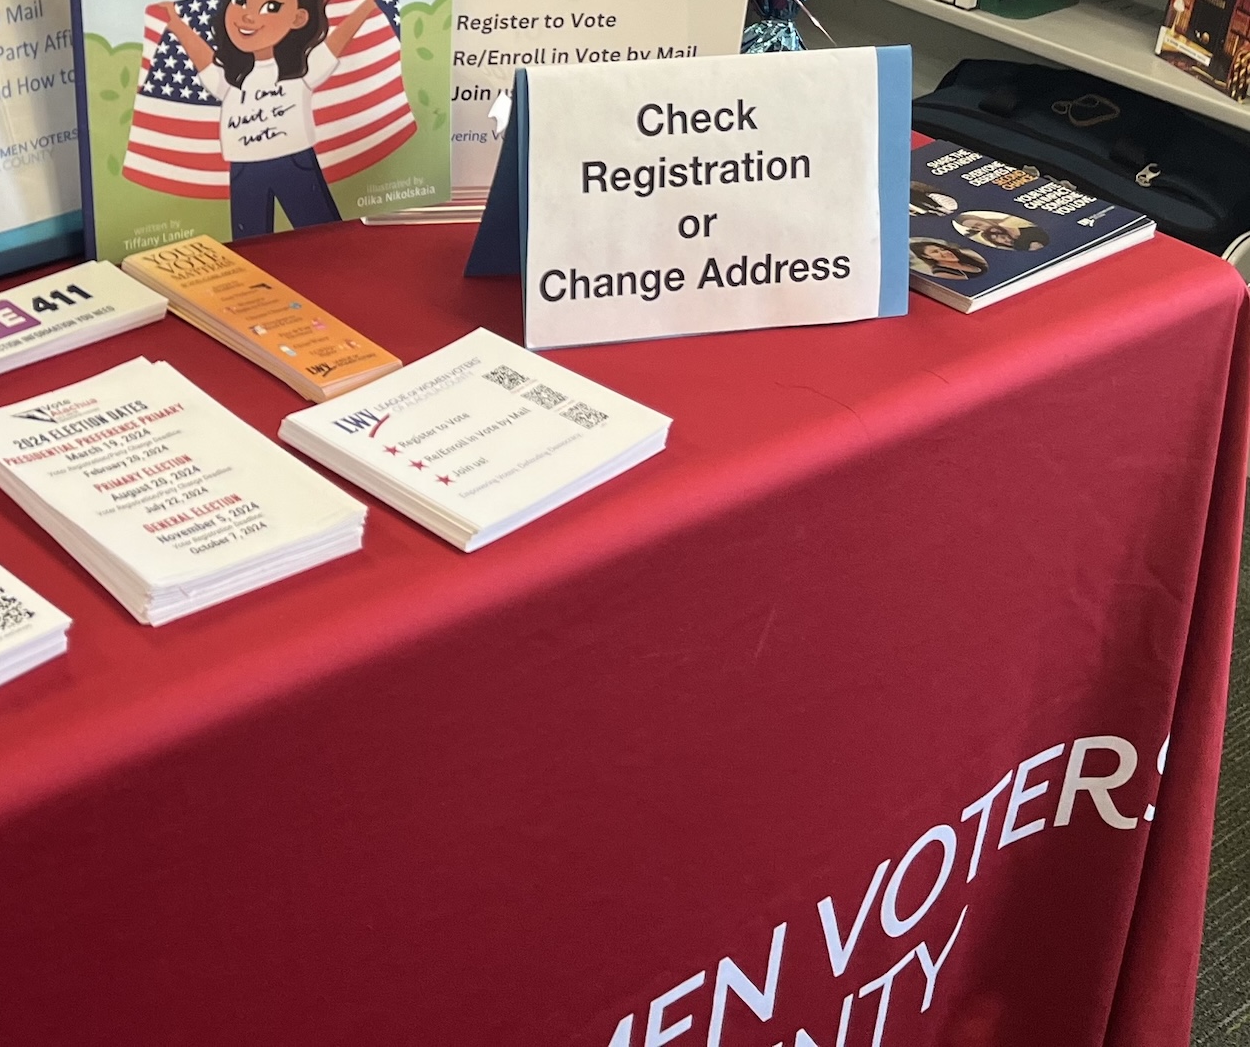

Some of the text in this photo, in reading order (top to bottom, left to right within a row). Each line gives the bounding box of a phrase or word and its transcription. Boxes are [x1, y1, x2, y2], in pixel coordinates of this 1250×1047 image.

[6, 0, 43, 24] Mail
[457, 13, 617, 35] Register to Vote
[453, 47, 620, 66] Re/Enroll Vote
[17, 72, 55, 97] How
[452, 85, 491, 101] Join
[637, 99, 757, 137] Check
[582, 149, 810, 198] Registration
[385, 185, 435, 204] Nikolskaia
[678, 212, 717, 239] or
[124, 227, 194, 251] Tiffany Lanier
[143, 242, 213, 265] YOUR
[155, 251, 220, 275] VOTE
[172, 258, 238, 281] MATTERS
[539, 253, 850, 302] Change Address
[32, 284, 93, 313] 411
[23, 320, 76, 343] INFORMATION
[94, 305, 115, 317] NEED
[48, 400, 149, 441] ELECTION DATES
[332, 408, 381, 434] LWV
[3, 403, 185, 466] PRESIDENTIAL PREFERENCE PRIMARY
[399, 427, 437, 449] Register
[423, 439, 466, 463] Re/Enroll
[94, 454, 192, 493] PRIMARY ELECTION
[192, 493, 242, 516] ELECTION
